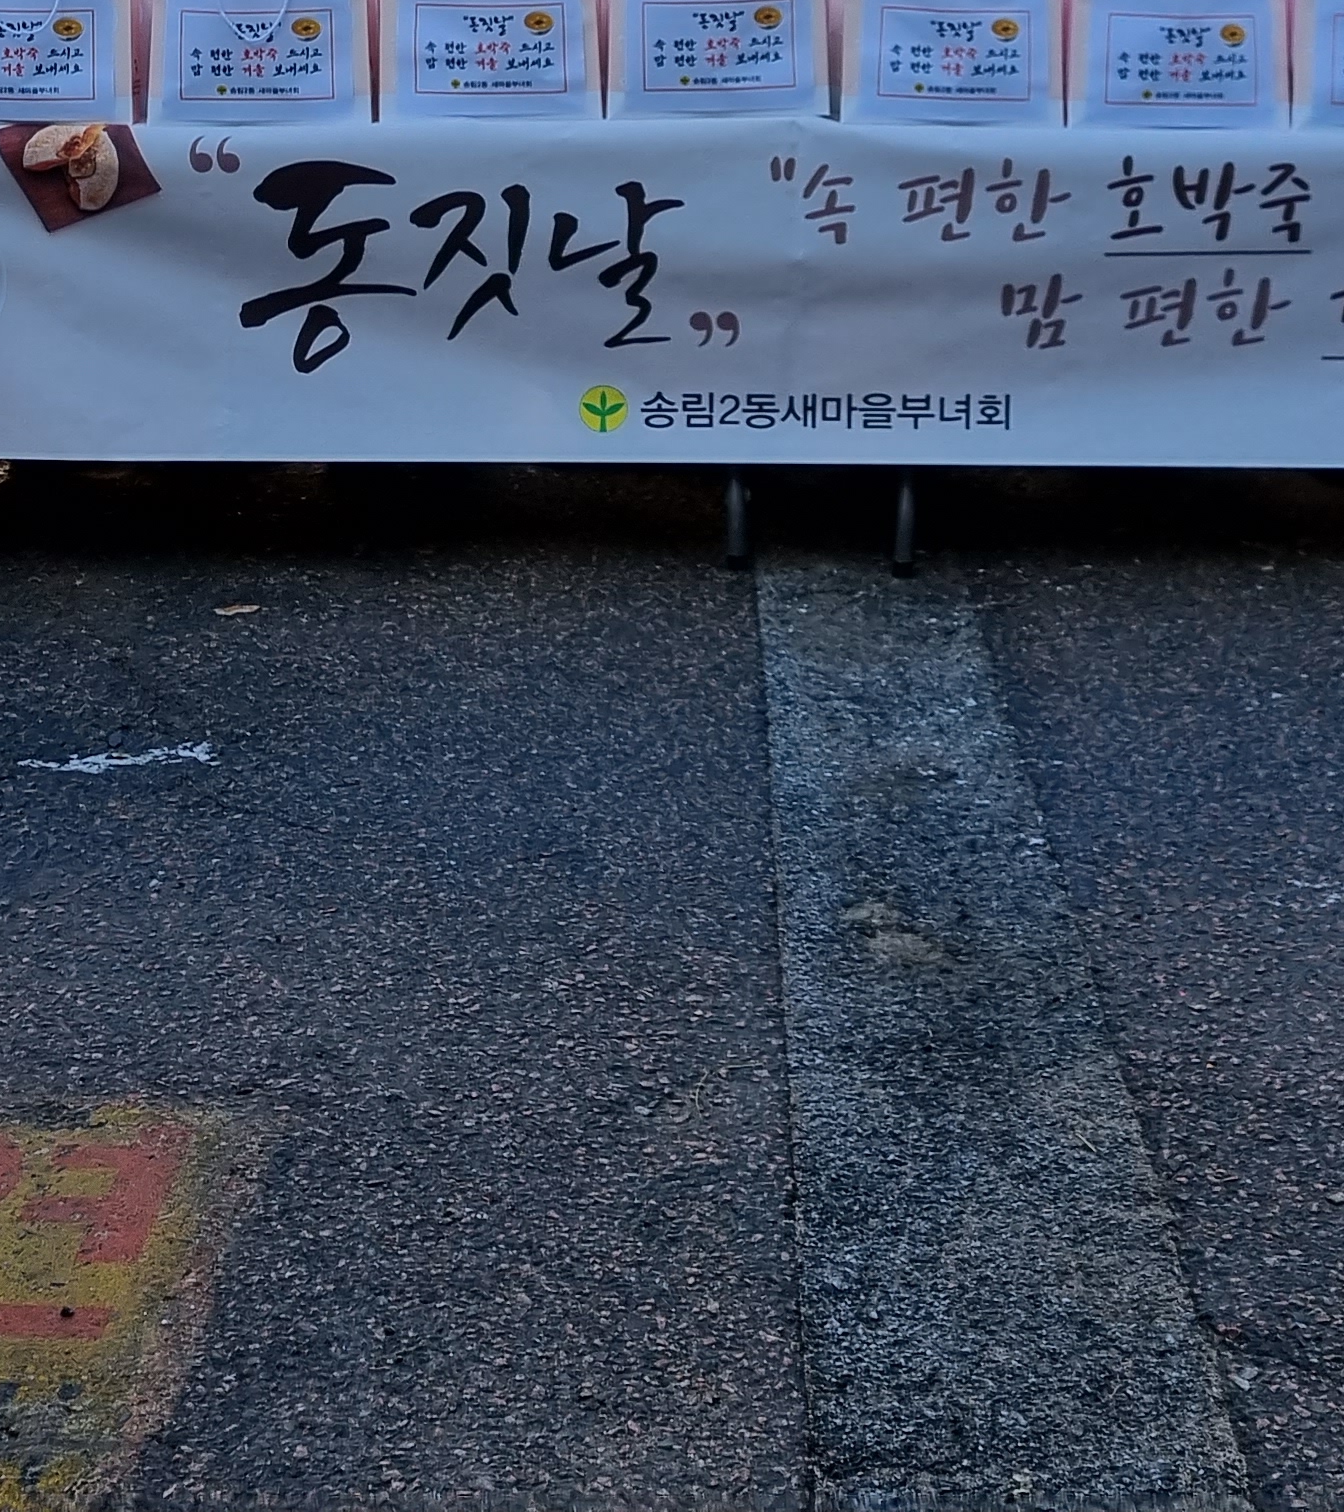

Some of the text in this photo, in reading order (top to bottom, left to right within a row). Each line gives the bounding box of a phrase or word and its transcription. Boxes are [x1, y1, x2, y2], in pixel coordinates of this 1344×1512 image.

[897, 154, 1072, 245] 편한
[1106, 154, 1313, 245] 호박죽
[1000, 272, 1084, 352] 맘
[1120, 272, 1293, 348] 편한
[639, 391, 1013, 435] 송림2동새마을부녀회
